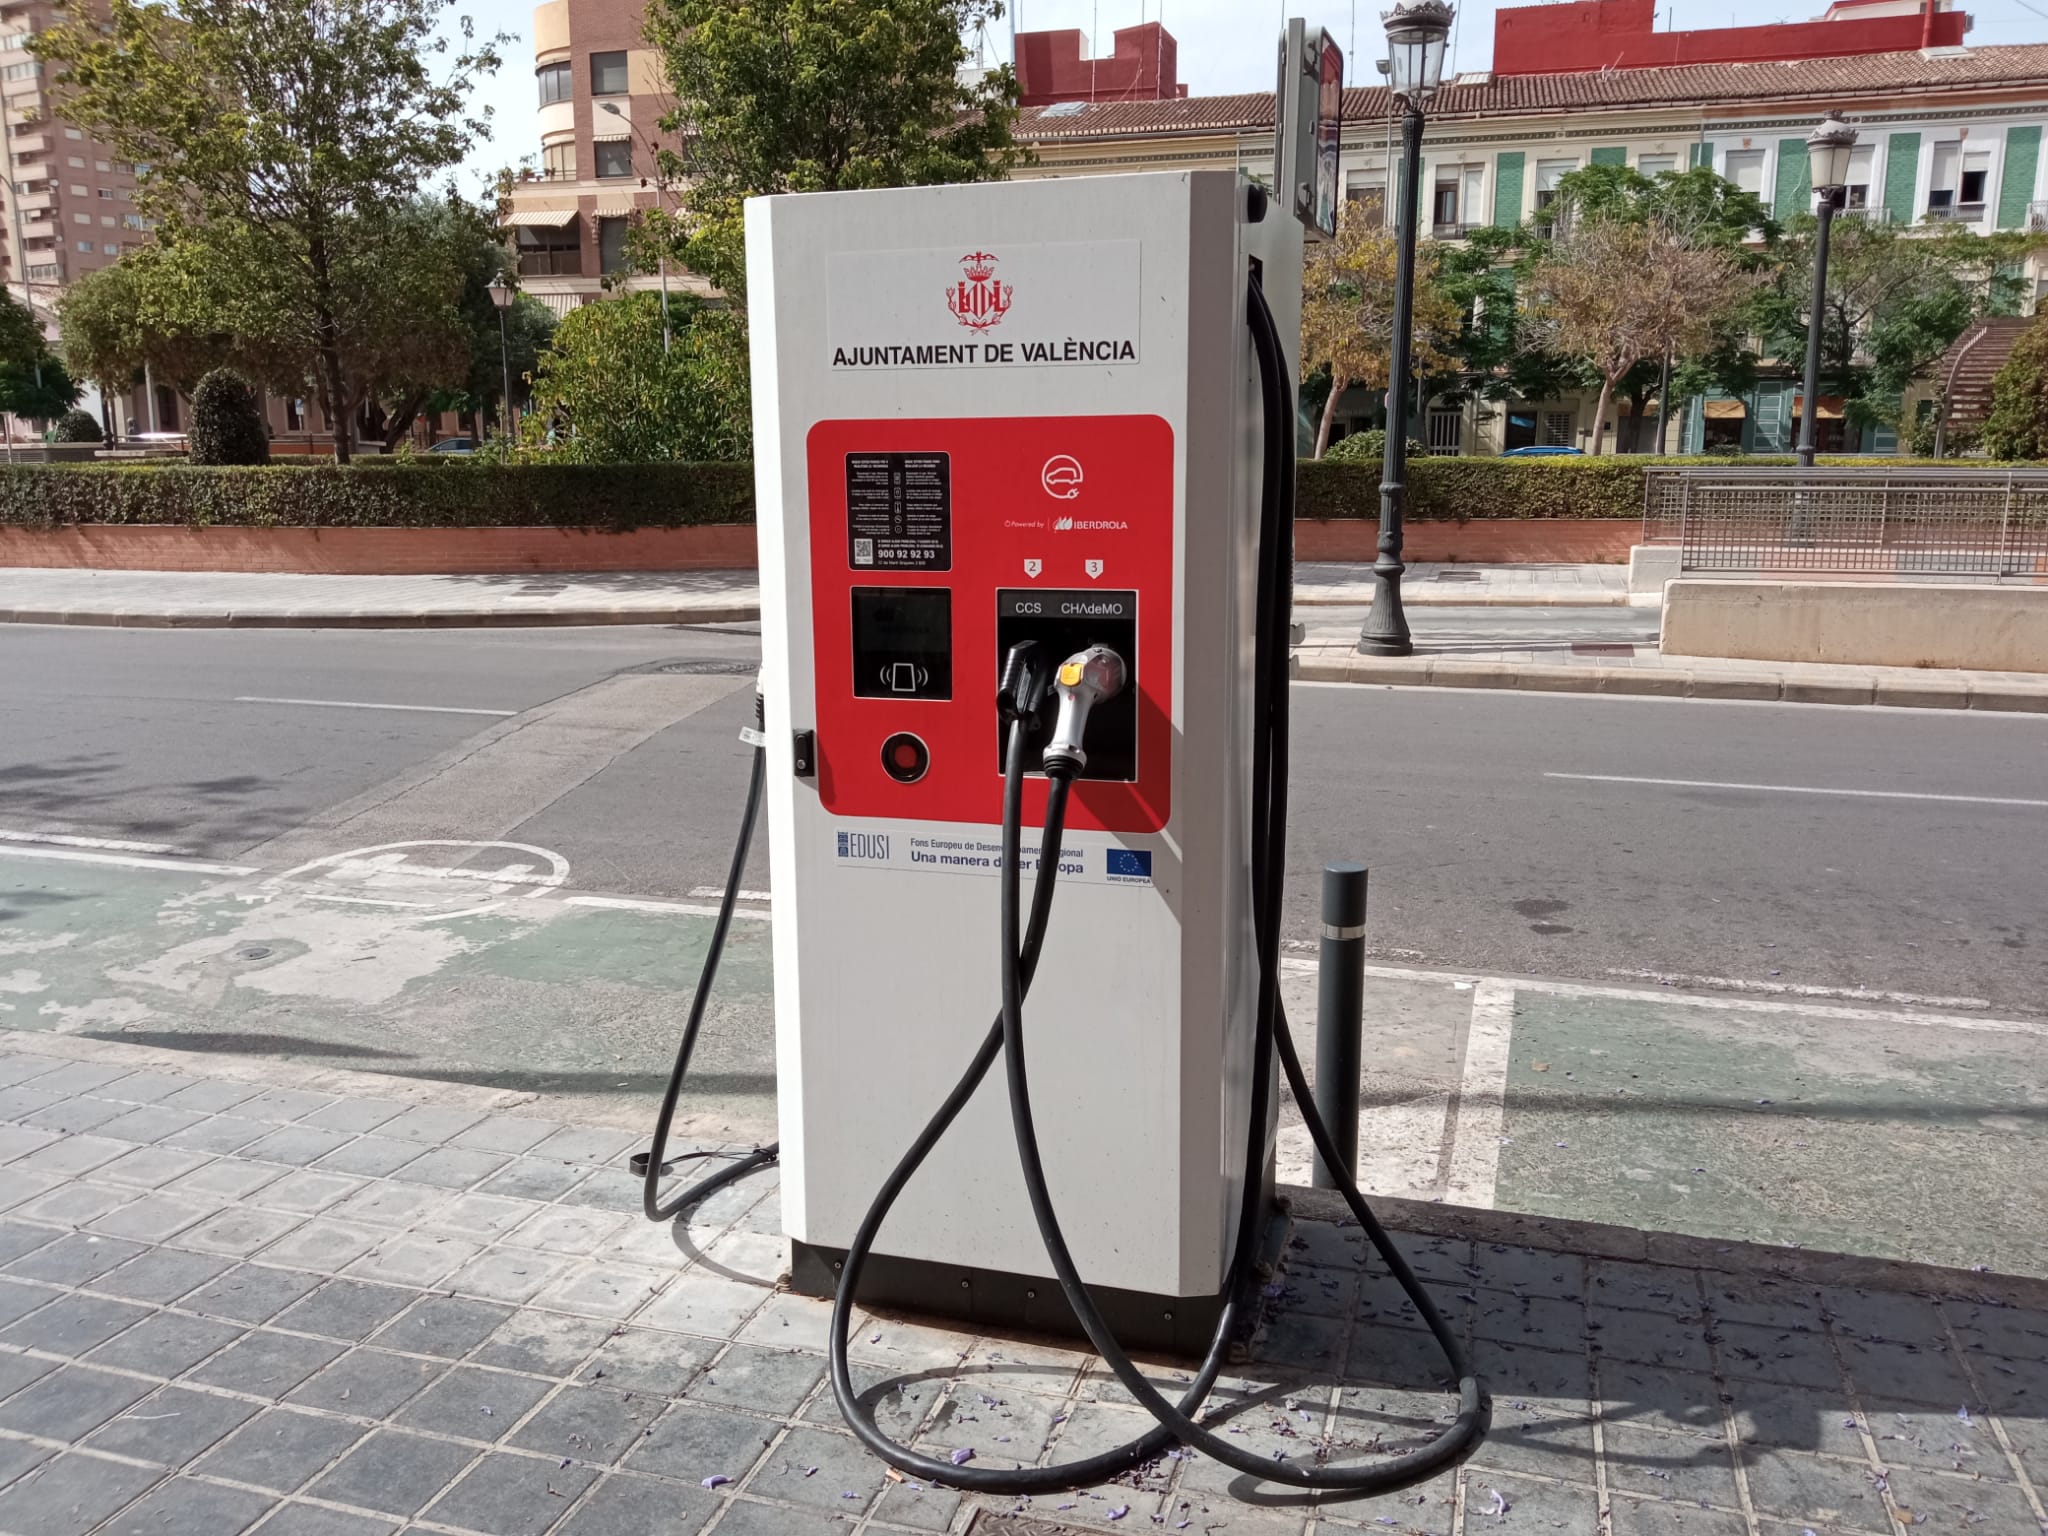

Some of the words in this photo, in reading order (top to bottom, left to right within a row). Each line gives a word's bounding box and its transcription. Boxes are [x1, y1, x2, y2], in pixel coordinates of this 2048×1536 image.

[832, 344, 978, 367] AJUNTAMENT
[984, 343, 1013, 363] DE
[1021, 337, 1136, 363] VALÈNCIA
[1073, 521, 1128, 530] IBERDROLA
[878, 549, 895, 559] 900
[896, 549, 908, 559] 92
[910, 550, 922, 560] 92
[923, 550, 935, 560] 93
[1028, 560, 1036, 572] 2
[1091, 561, 1098, 573] 3
[1015, 601, 1042, 614] CCS
[850, 833, 890, 860] EDUSI
[910, 837, 929, 848] Fons
[931, 839, 963, 851] Europeu
[964, 841, 975, 850] de
[911, 850, 937, 863] Una
[940, 853, 990, 867] manera
[1035, 858, 1084, 876] Eopa
